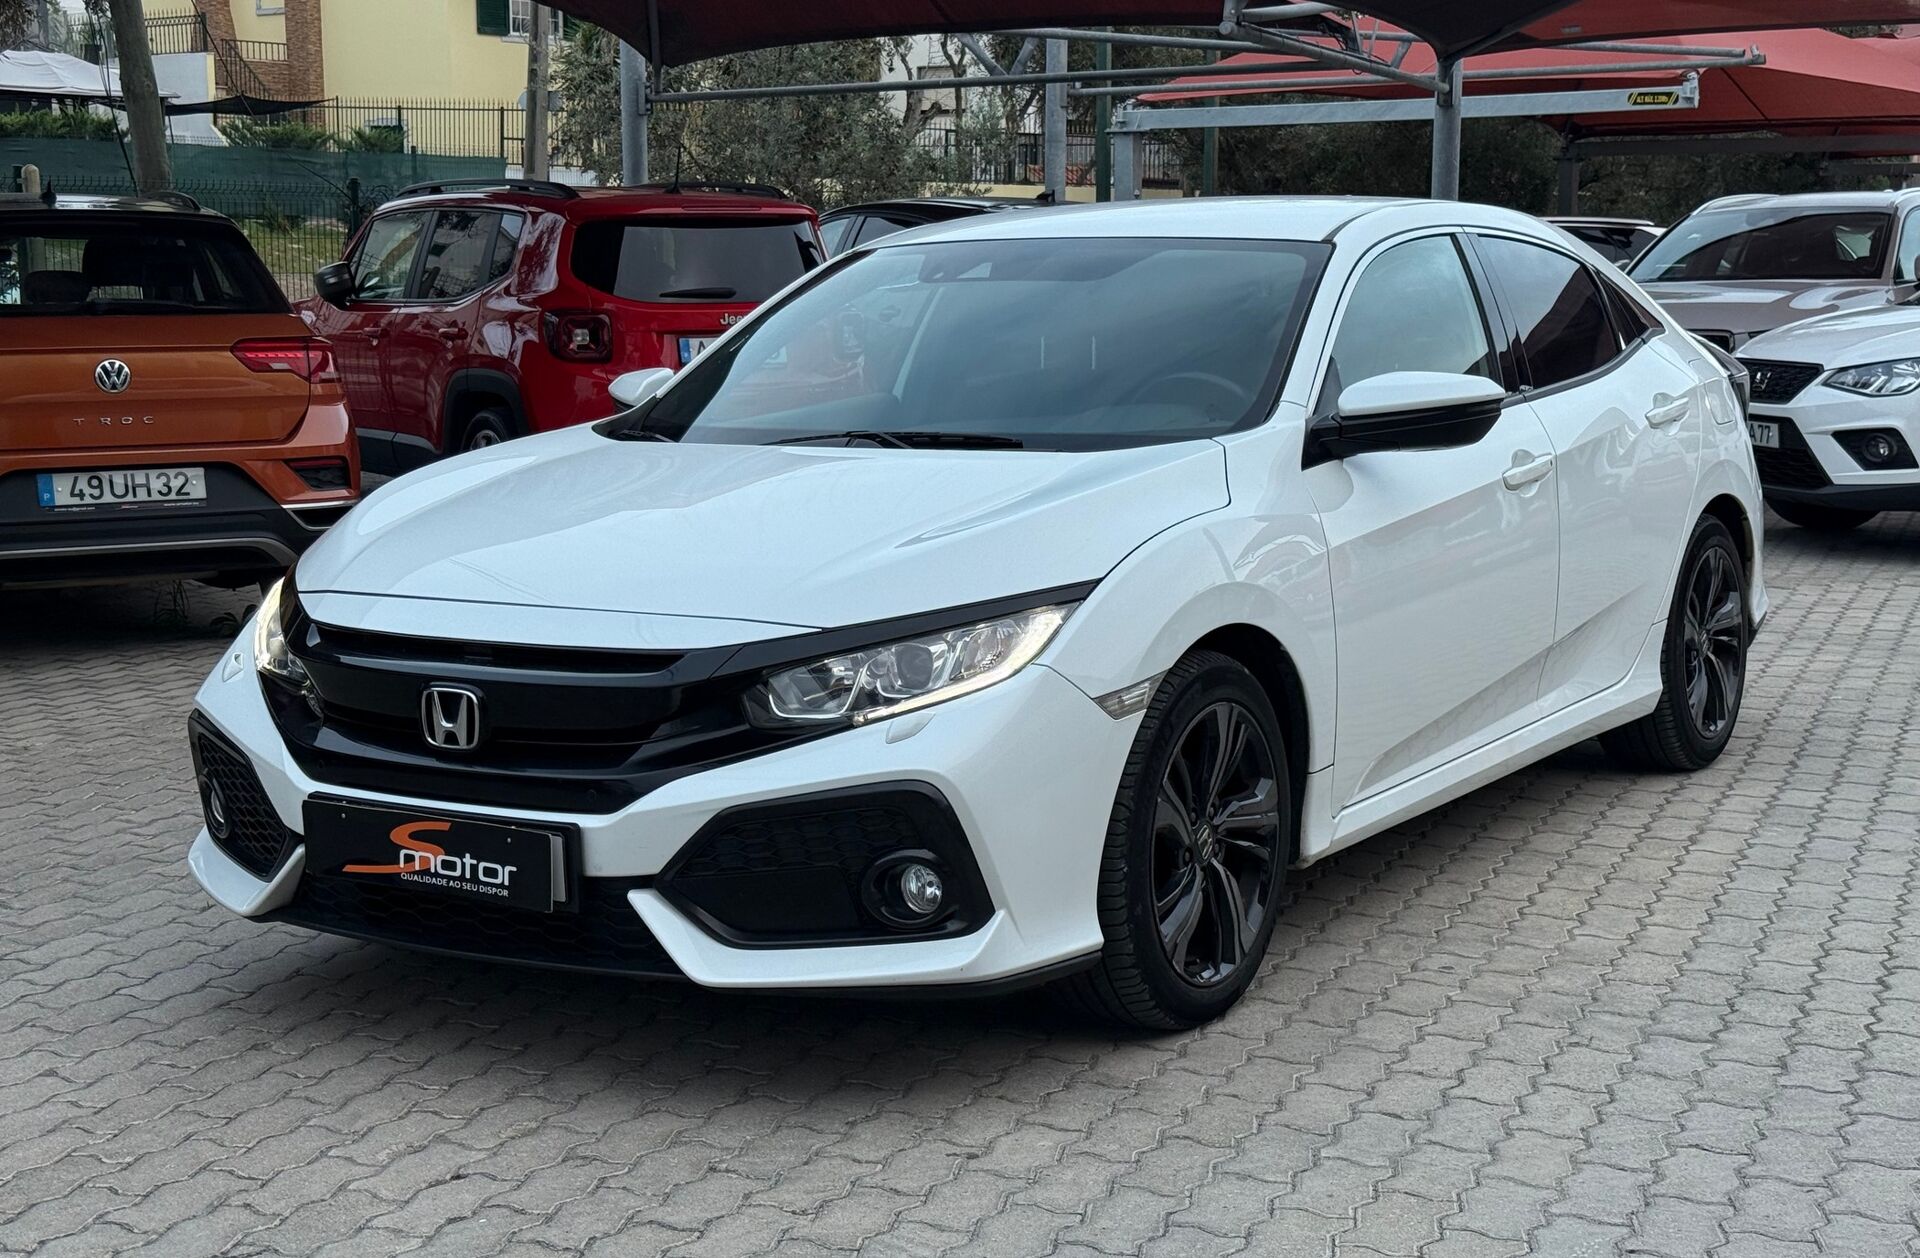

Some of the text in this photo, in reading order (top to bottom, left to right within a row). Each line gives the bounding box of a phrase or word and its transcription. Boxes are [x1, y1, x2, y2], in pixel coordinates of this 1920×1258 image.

[719, 312, 747, 325] Jee
[1749, 423, 1771, 444] A77
[400, 872, 509, 898] QUALIDADE AO SEU DISPOR
